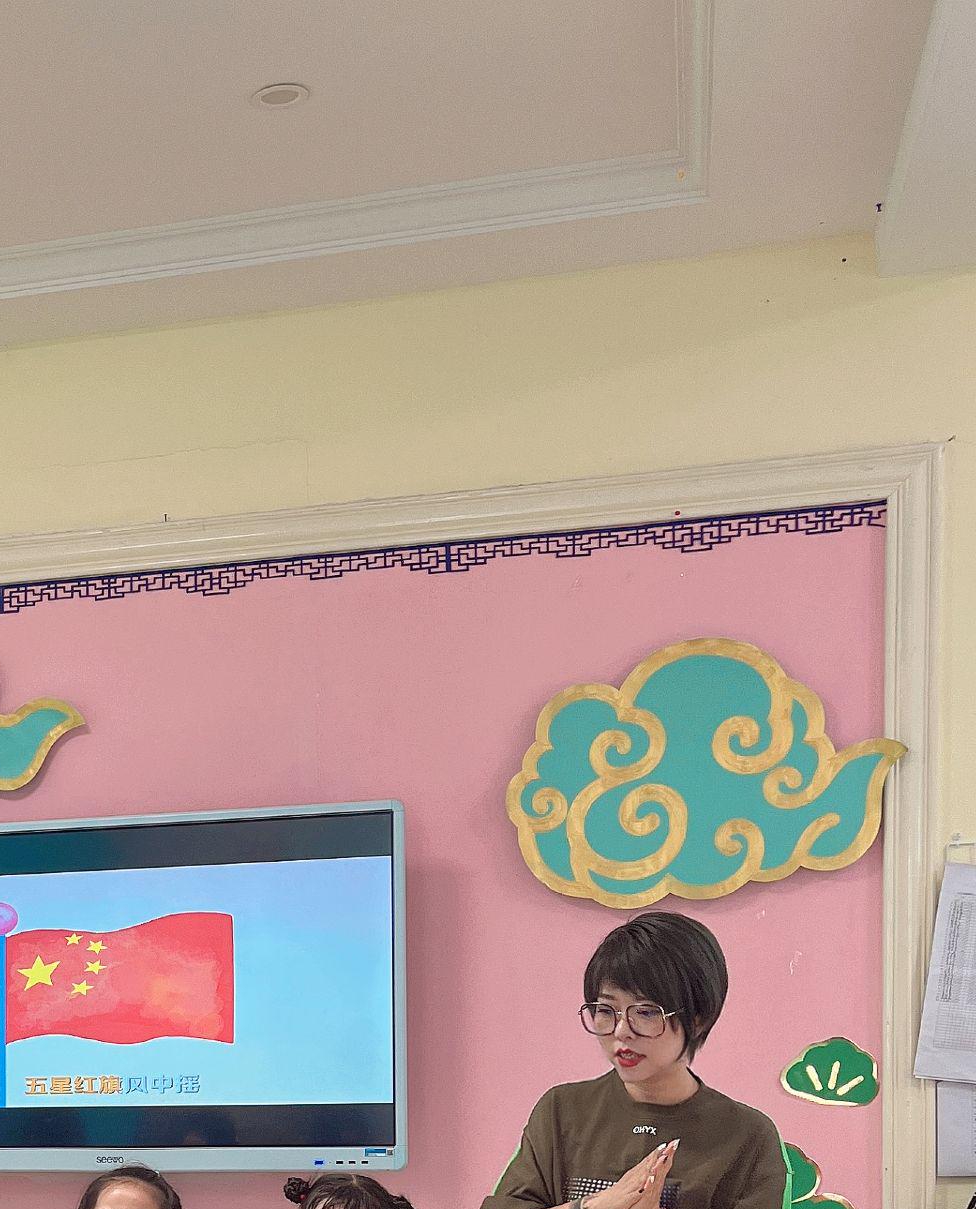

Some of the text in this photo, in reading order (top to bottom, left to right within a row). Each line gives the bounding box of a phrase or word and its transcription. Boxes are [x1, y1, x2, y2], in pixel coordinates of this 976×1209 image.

[24, 1074, 200, 1095] 五星红旗风中摇
